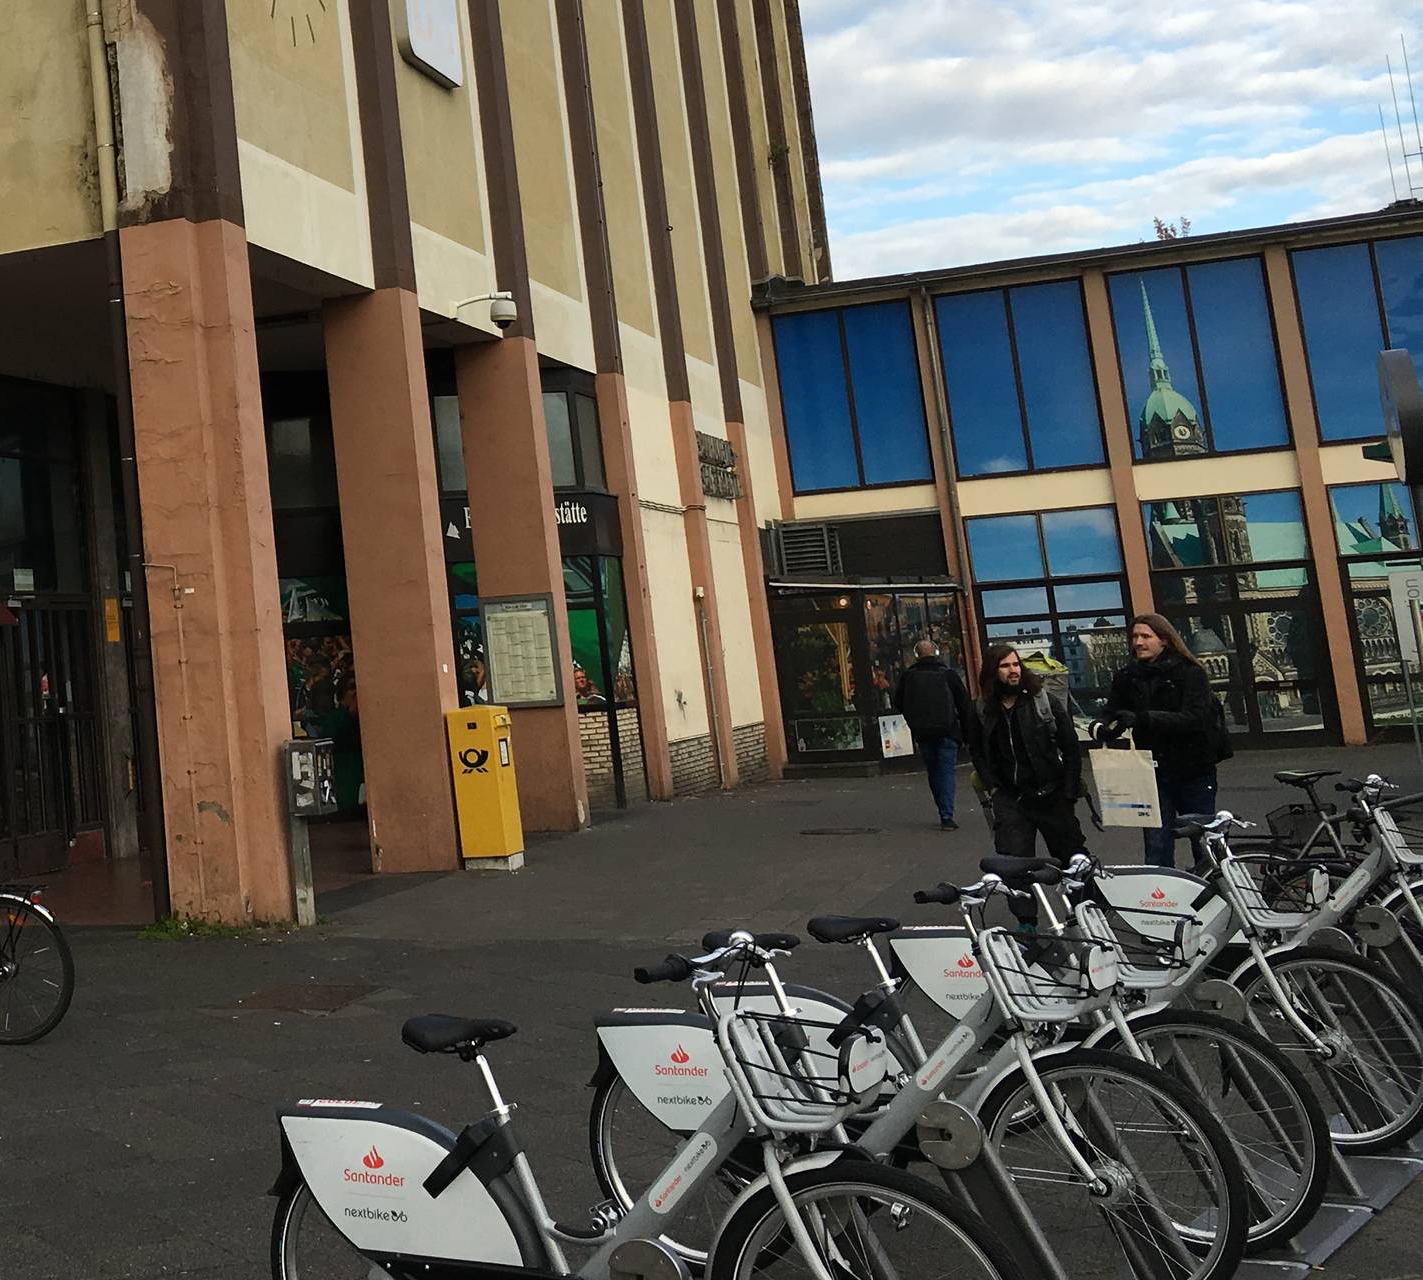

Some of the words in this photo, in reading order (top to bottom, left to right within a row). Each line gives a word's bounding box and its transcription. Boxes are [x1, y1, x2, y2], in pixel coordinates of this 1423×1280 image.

[655, 1065, 708, 1077] Santander
[657, 1096, 697, 1105] nextbike
[344, 1168, 406, 1187] Santander
[344, 1206, 390, 1221] nextbike
